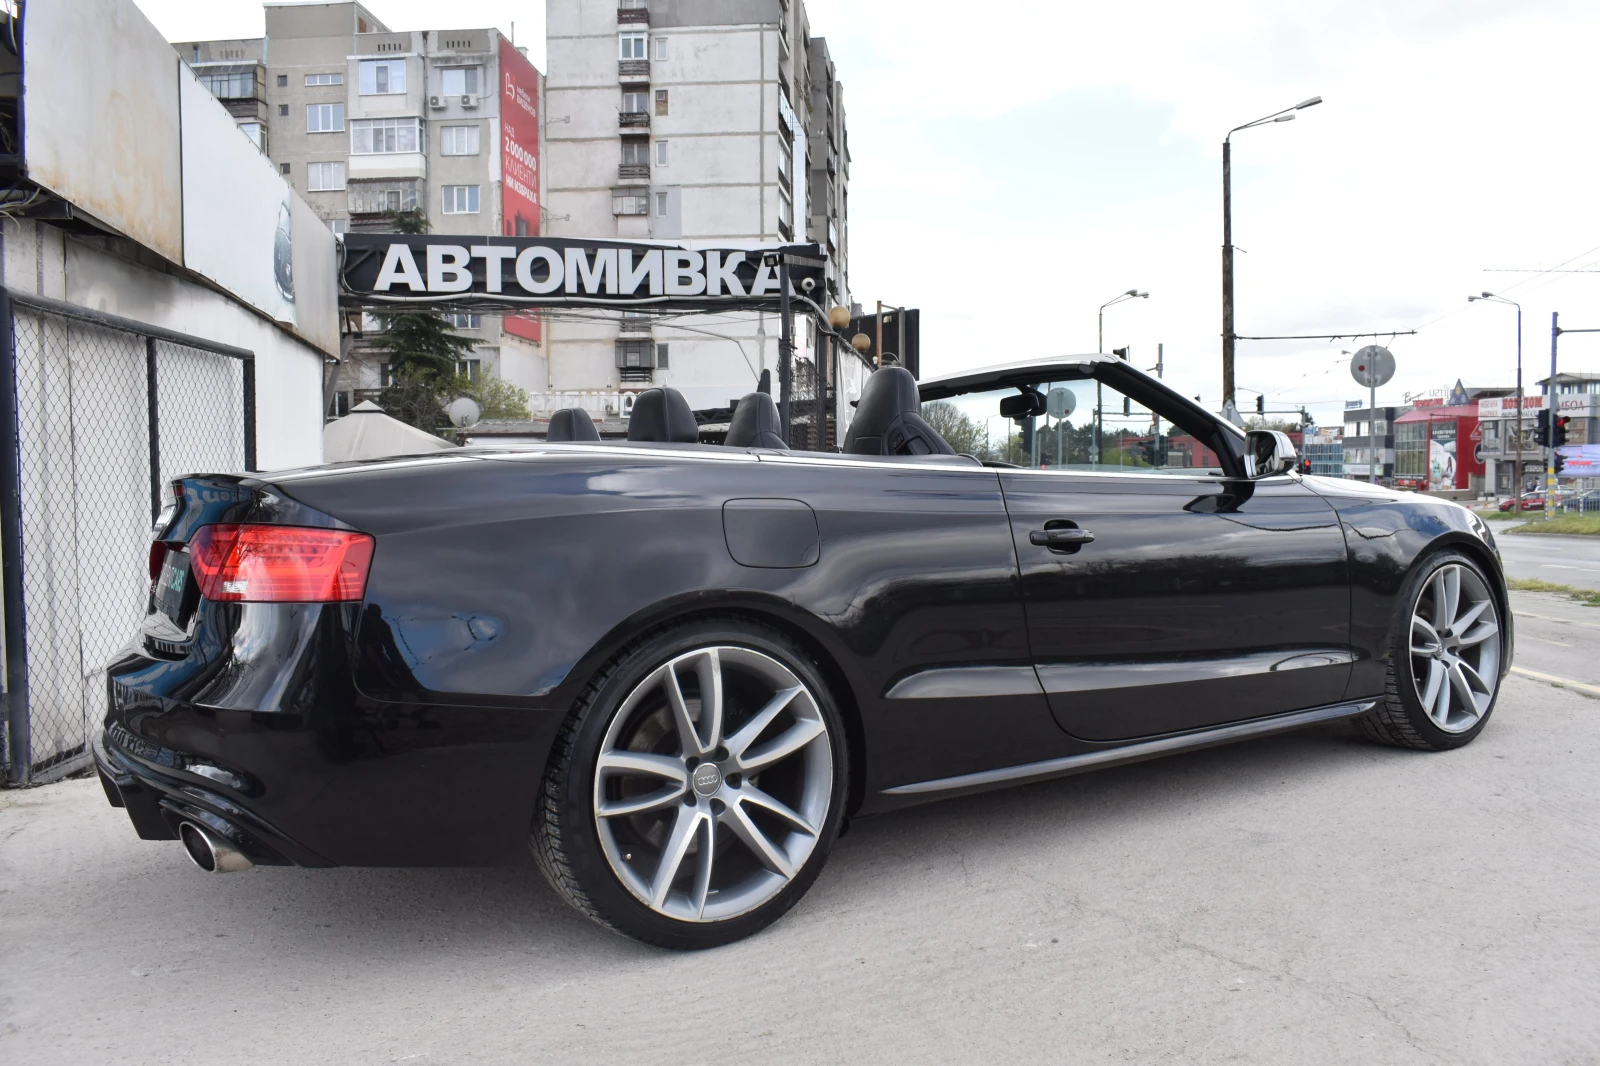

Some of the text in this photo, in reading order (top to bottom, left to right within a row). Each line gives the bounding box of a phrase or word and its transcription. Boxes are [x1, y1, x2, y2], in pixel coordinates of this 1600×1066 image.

[504, 122, 516, 139] НАД
[505, 154, 537, 189] КЛИЕНТИ
[373, 244, 797, 297] АВТОМИВКА
